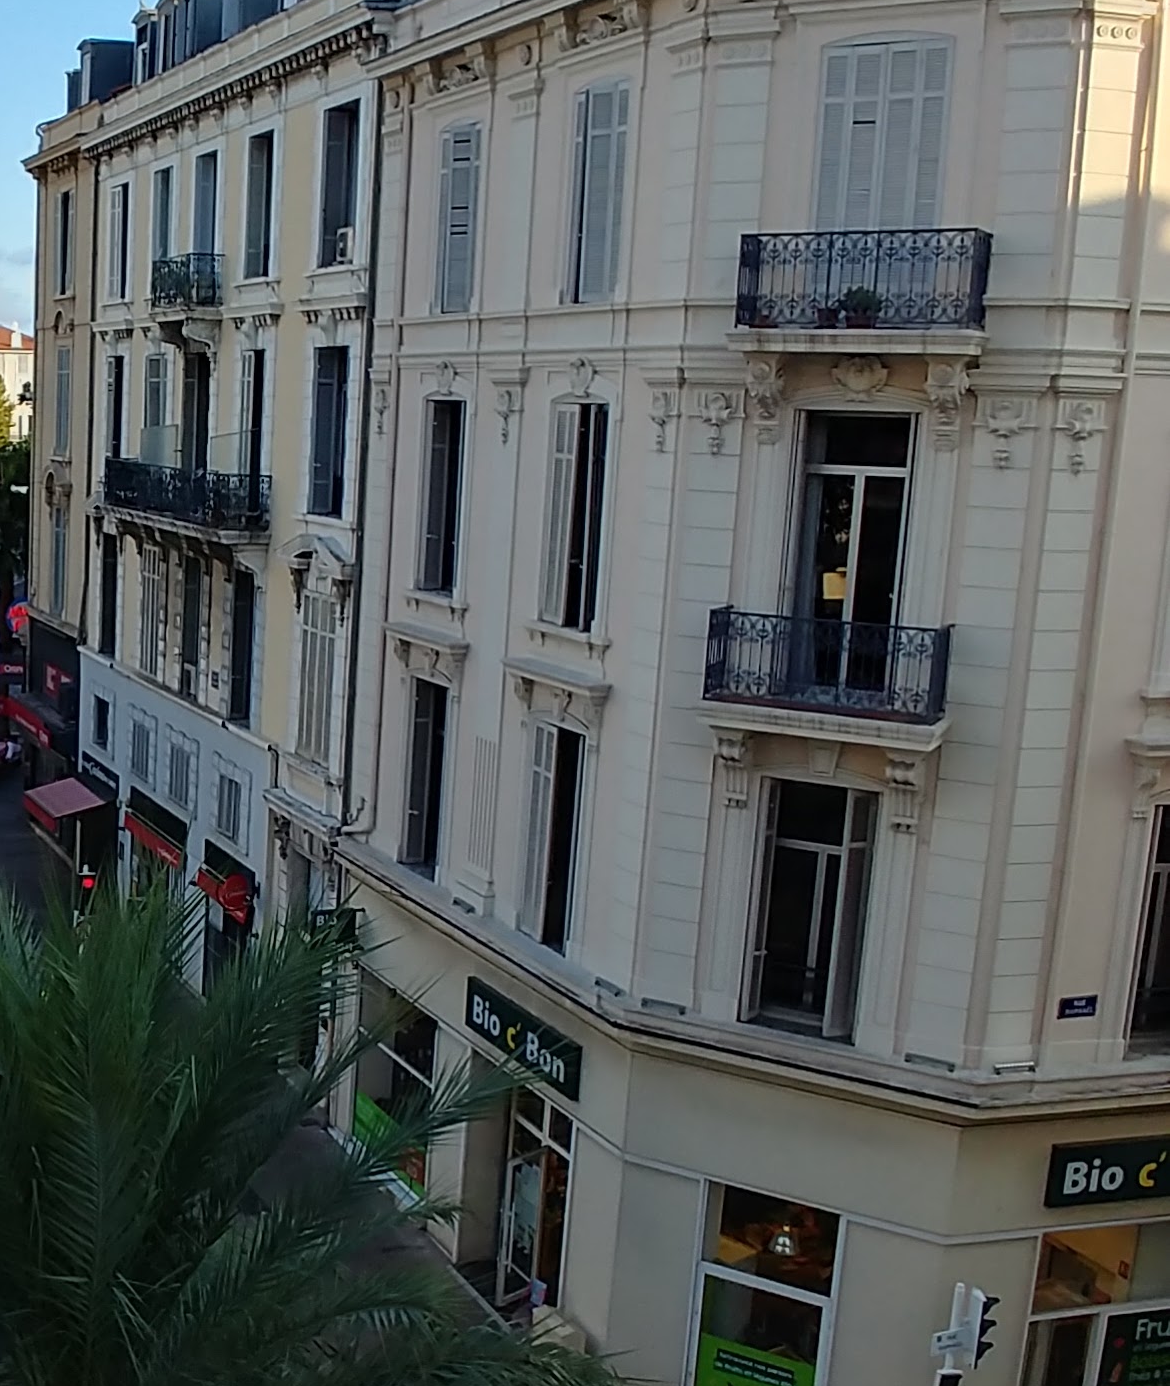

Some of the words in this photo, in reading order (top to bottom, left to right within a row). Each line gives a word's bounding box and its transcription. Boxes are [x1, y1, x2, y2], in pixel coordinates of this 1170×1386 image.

[472, 994, 501, 1037] Bio
[526, 1031, 565, 1084] Bon
[1062, 1158, 1125, 1195] Bio
